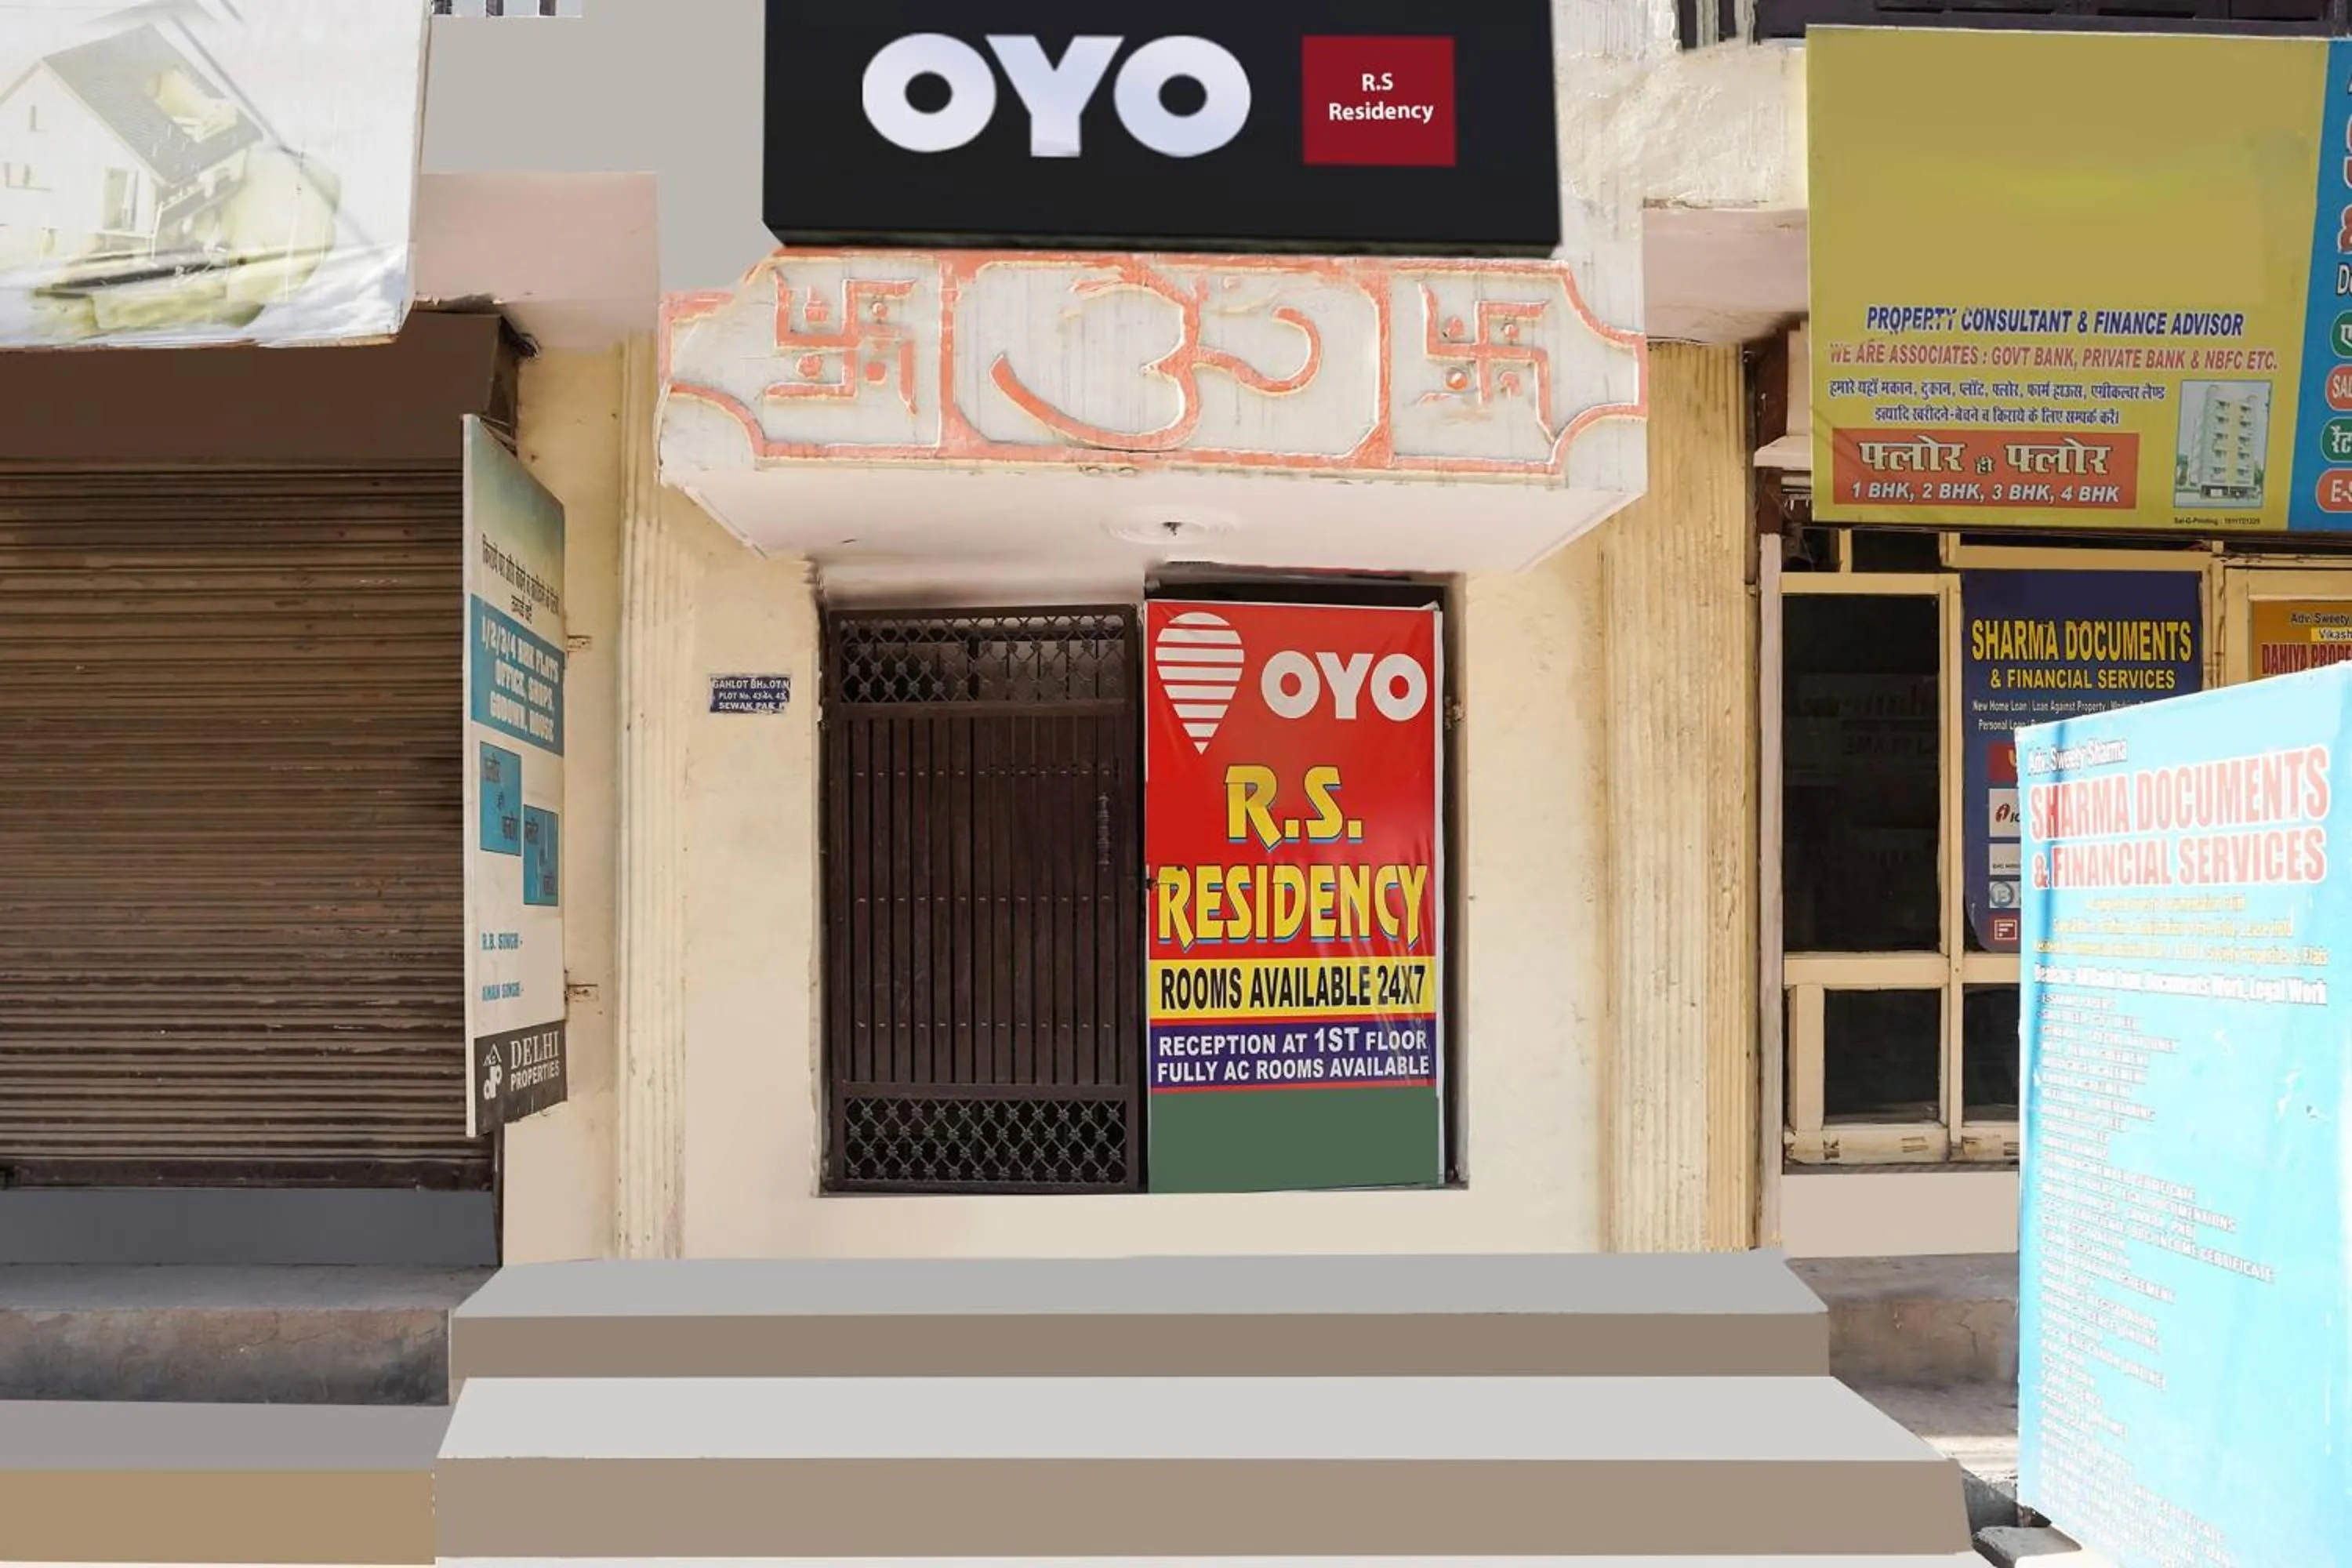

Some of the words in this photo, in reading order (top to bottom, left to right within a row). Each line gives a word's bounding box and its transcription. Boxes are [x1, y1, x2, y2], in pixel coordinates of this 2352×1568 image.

[862, 33, 1251, 157] OYO
[1362, 72, 1393, 93] R.S
[1328, 100, 1434, 124] Residency
[1867, 306, 1957, 331] PROPERTY
[1961, 307, 2072, 333] CONSULTANT
[2078, 310, 2088, 333] &
[2094, 310, 2168, 336] FINANCE
[2171, 313, 2245, 336] ADVISOR
[1830, 343, 1851, 364] WE
[1856, 343, 1886, 364] ARE
[1889, 343, 1979, 365] ASSOCIATES
[1992, 346, 2031, 366] GOVT
[2034, 347, 2078, 370] BANK,
[2082, 348, 2143, 368] PRIVATE
[2146, 350, 2185, 369] BANK
[2190, 350, 2199, 369] &
[2205, 350, 2243, 370] NBFC
[2246, 351, 2278, 370] ETC.
[1859, 435, 1966, 472] फ्लोर
[2005, 437, 2112, 474] फ्लोर
[1852, 482, 1861, 498] 1
[1868, 482, 1915, 503] BHK,
[1922, 484, 1933, 498] 2
[1939, 484, 1985, 503] BHK,
[1992, 485, 2003, 500] 3
[2009, 485, 2055, 504] BHK,
[2060, 485, 2073, 501] 4
[2079, 485, 2120, 503] BHK
[2314, 612, 2350, 626] Sweety
[1972, 619, 2060, 661] SHARMA
[2065, 620, 2192, 662] DOCUMENTS
[1260, 650, 1428, 722] OYO
[1990, 669, 2002, 689] &
[2007, 669, 2092, 690] FINANCIAL
[2097, 670, 2176, 690] SERVICES
[1224, 764, 1363, 851] R.S.
[2030, 775, 2131, 840] SHARMA
[2136, 746, 2328, 830] DOCUMENTS
[2033, 853, 2049, 887] &
[2053, 839, 2172, 887] FINANCIAL
[2177, 827, 2325, 885] SERVICES
[1156, 865, 1428, 953] RESIDENCY
[1160, 967, 1243, 1011] ROOMS
[1250, 965, 1371, 1008] AVAILABLE
[1377, 964, 1425, 1006] 24X7
[510, 1030, 560, 1070] DELHI
[1159, 1033, 1276, 1056] RECEPTION
[1283, 1033, 1308, 1054] AT
[1314, 1026, 1360, 1053] 1ST
[1365, 1030, 1428, 1052] FLOOR
[510, 1059, 560, 1092] PROPERTIES
[1157, 1061, 1218, 1083] FULLY
[1224, 1060, 1250, 1080] AC
[1256, 1058, 1324, 1080] ROOMS
[1329, 1056, 1430, 1078] AVAILABLE
